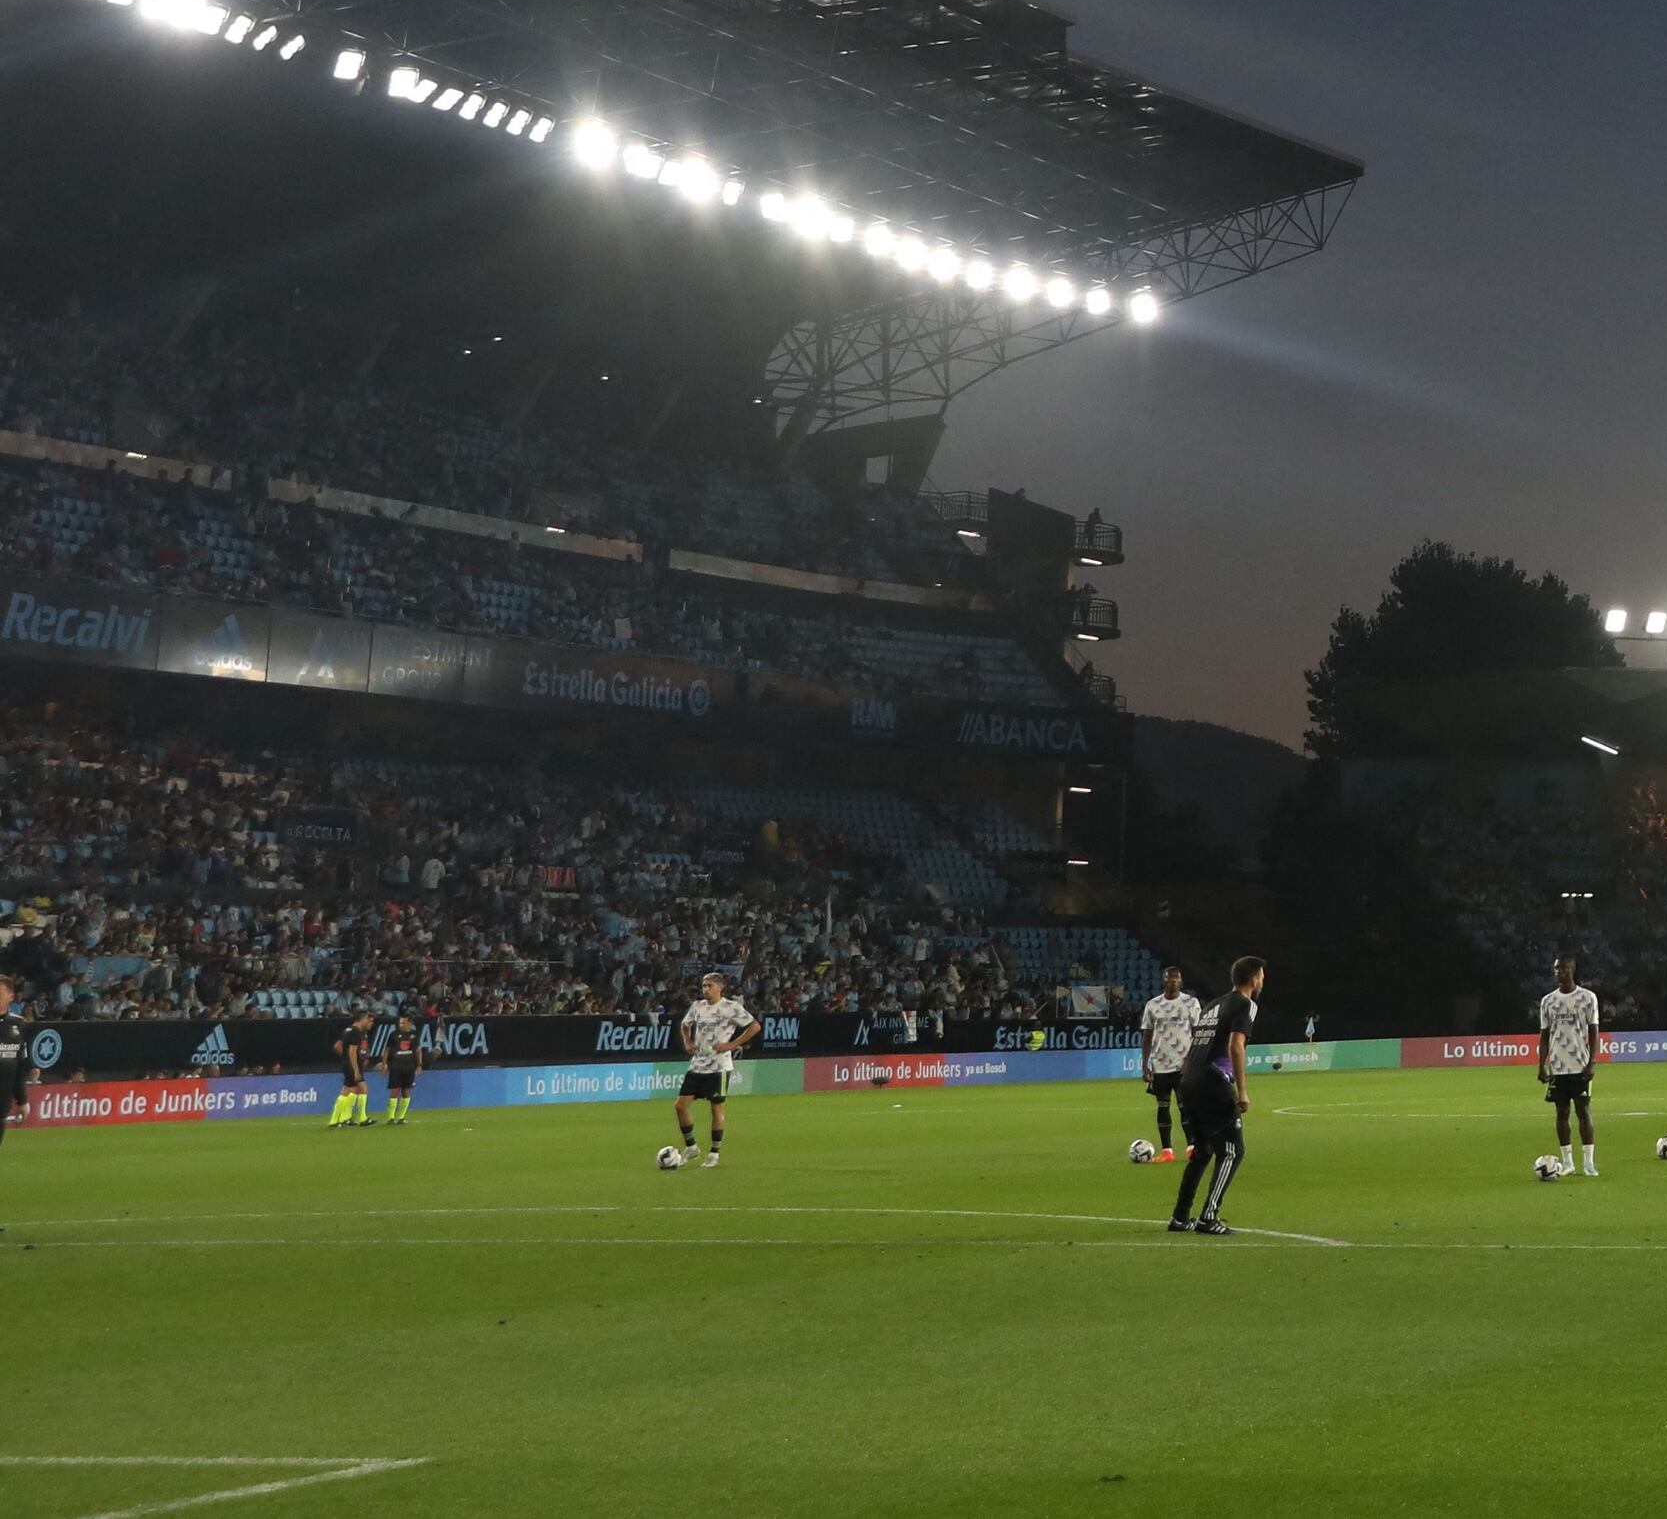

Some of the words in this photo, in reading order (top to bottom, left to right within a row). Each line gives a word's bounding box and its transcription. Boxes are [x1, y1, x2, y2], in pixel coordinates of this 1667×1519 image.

[1, 593, 153, 654] Recalvi
[523, 659, 607, 702] Estrella
[611, 670, 682, 711] Galicia
[851, 696, 897, 731] RAW
[596, 1020, 672, 1051] Recalvi
[763, 1017, 800, 1040] RAW
[1072, 1025, 1142, 1050] Galicia
[191, 1049, 234, 1066] adidas
[1246, 1053, 1263, 1066] ya
[1265, 1053, 1280, 1064] es
[1282, 1051, 1319, 1063] Bosch
[1444, 1041, 1465, 1059] Lo
[1471, 1039, 1530, 1058] último
[1598, 1038, 1637, 1055] kers
[1645, 1042, 1660, 1054] ya
[834, 1064, 849, 1082] Lo
[853, 1061, 893, 1082] último
[896, 1061, 912, 1079] de
[915, 1060, 962, 1079] Junkers
[965, 1065, 975, 1078] ya
[975, 1065, 985, 1076] es
[985, 1062, 1007, 1074] Bosch
[1123, 1055, 1135, 1071] Lo
[527, 1075, 546, 1096] Lo
[551, 1071, 600, 1094] último
[605, 1071, 623, 1092] de
[628, 1070, 684, 1092] Junkers
[39, 1092, 112, 1120] último
[120, 1090, 148, 1115] de
[155, 1088, 236, 1114] Junkers
[243, 1091, 259, 1109] ya
[261, 1092, 276, 1104] es
[279, 1088, 318, 1104] Bosch
